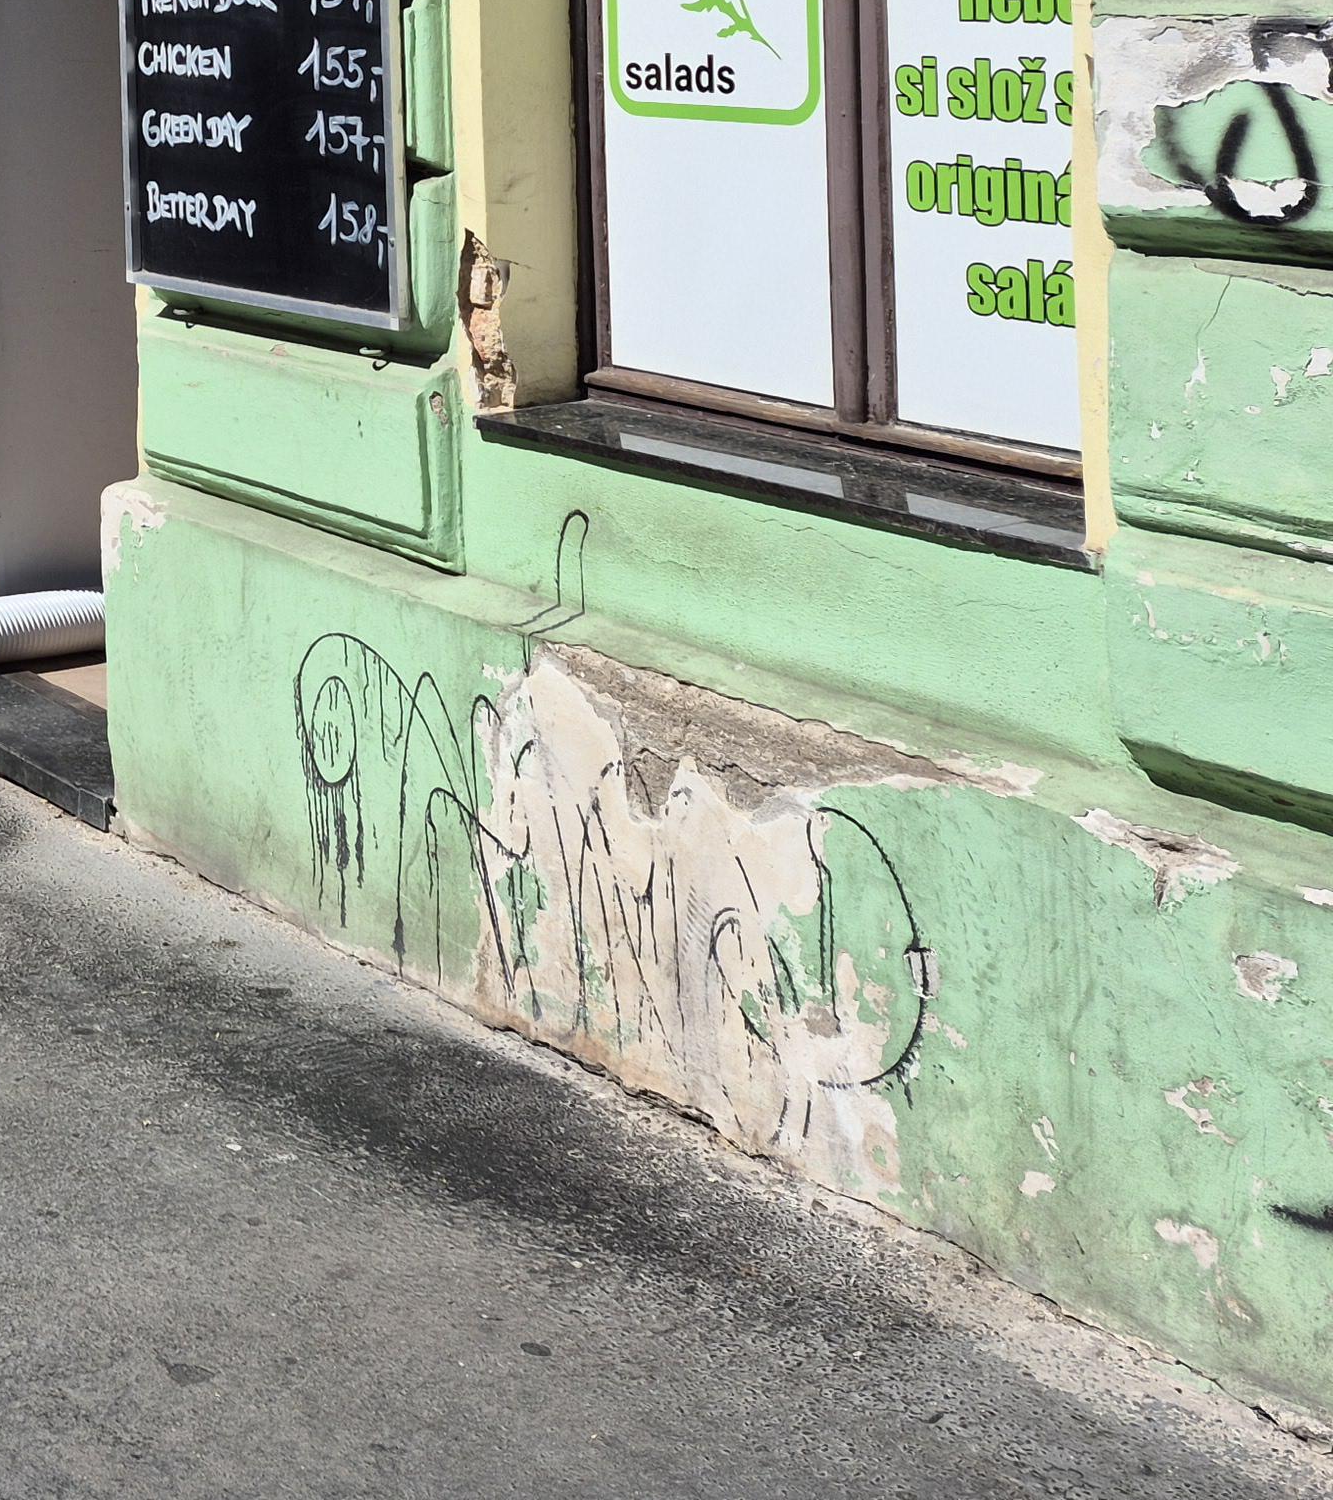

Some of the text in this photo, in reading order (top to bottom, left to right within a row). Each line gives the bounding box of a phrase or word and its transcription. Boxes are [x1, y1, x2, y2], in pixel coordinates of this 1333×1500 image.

[137, 41, 232, 80] CHICKEN
[625, 52, 736, 95] salads
[895, 56, 940, 118] si
[946, 56, 1048, 125] slož
[141, 108, 203, 148] GREEN
[205, 111, 253, 153] DAY
[146, 180, 216, 232] BETTER
[213, 194, 256, 239] DAY
